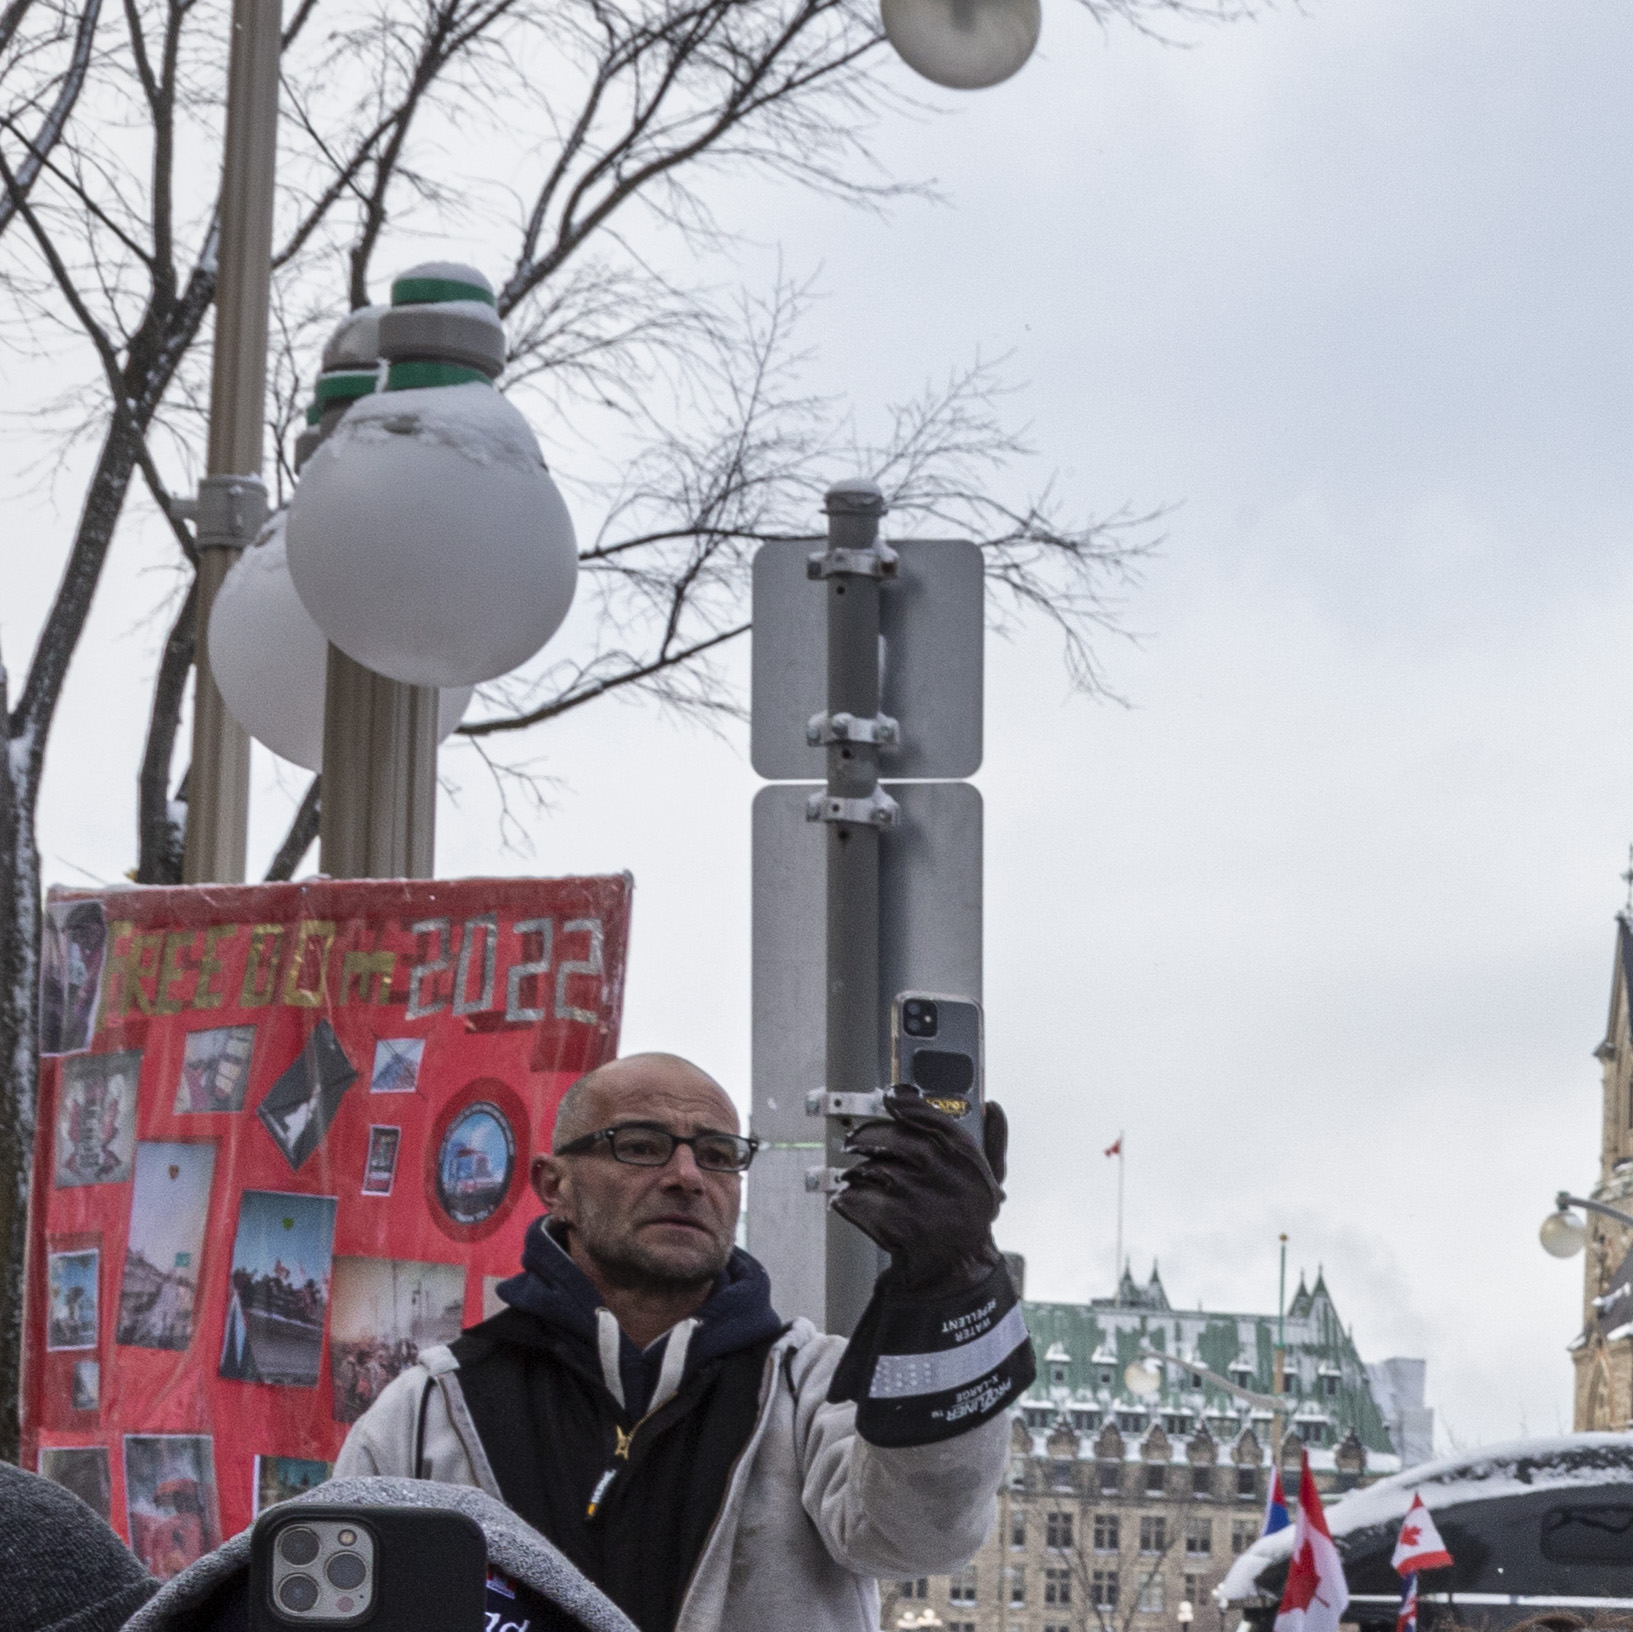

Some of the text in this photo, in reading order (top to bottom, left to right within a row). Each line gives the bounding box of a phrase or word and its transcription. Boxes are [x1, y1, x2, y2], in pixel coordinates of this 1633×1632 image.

[405, 912, 602, 1025] 2022
[955, 1318, 991, 1342] WATER
[956, 1374, 999, 1401] X-LARGE
